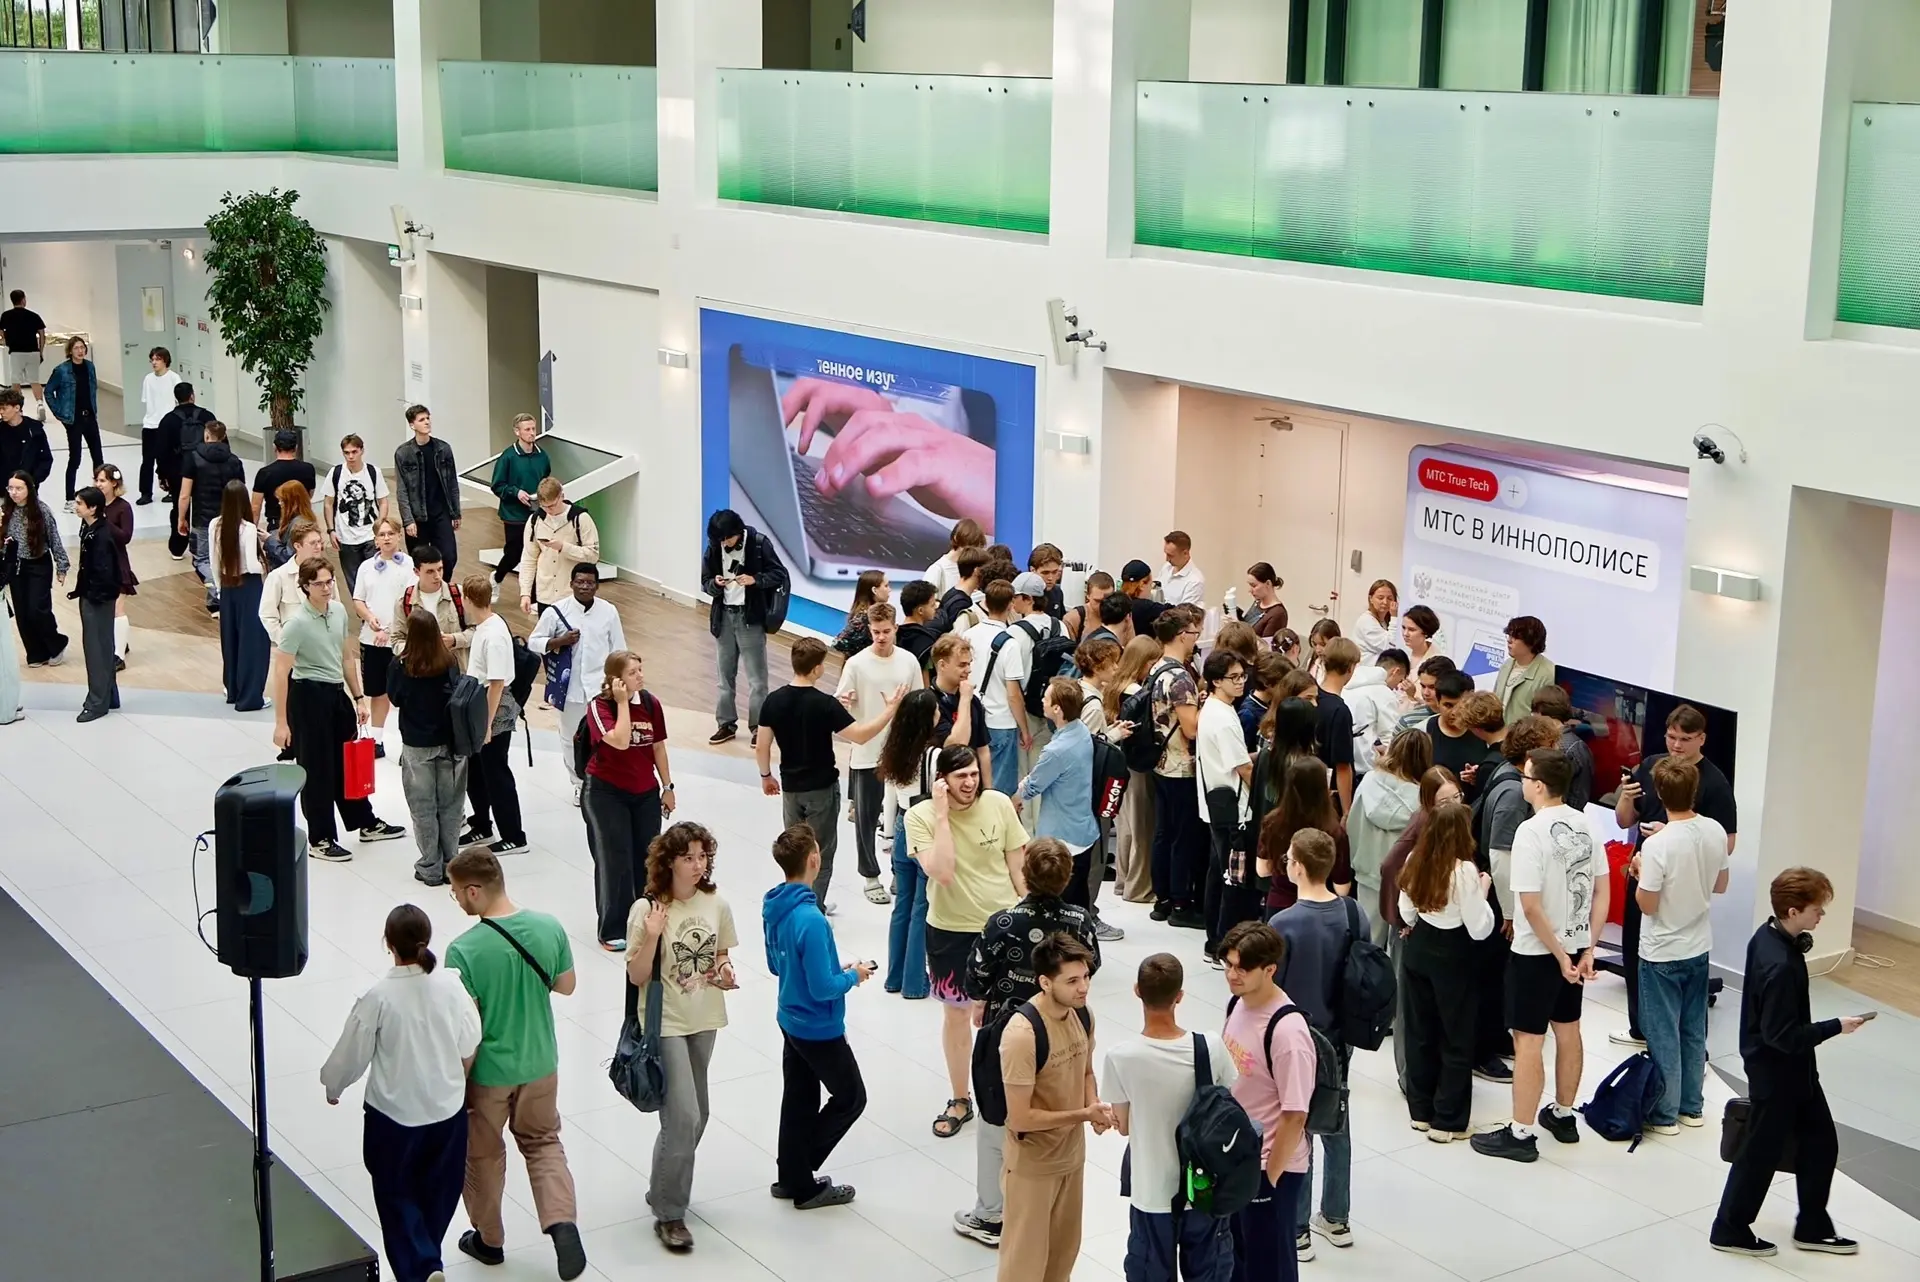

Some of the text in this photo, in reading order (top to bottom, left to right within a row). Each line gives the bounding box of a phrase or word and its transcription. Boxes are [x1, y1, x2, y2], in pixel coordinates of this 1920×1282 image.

[1426, 468, 1489, 492] МТС True Tech
[1423, 506, 1649, 578] МТС В ИННОПОЛИСЕ
